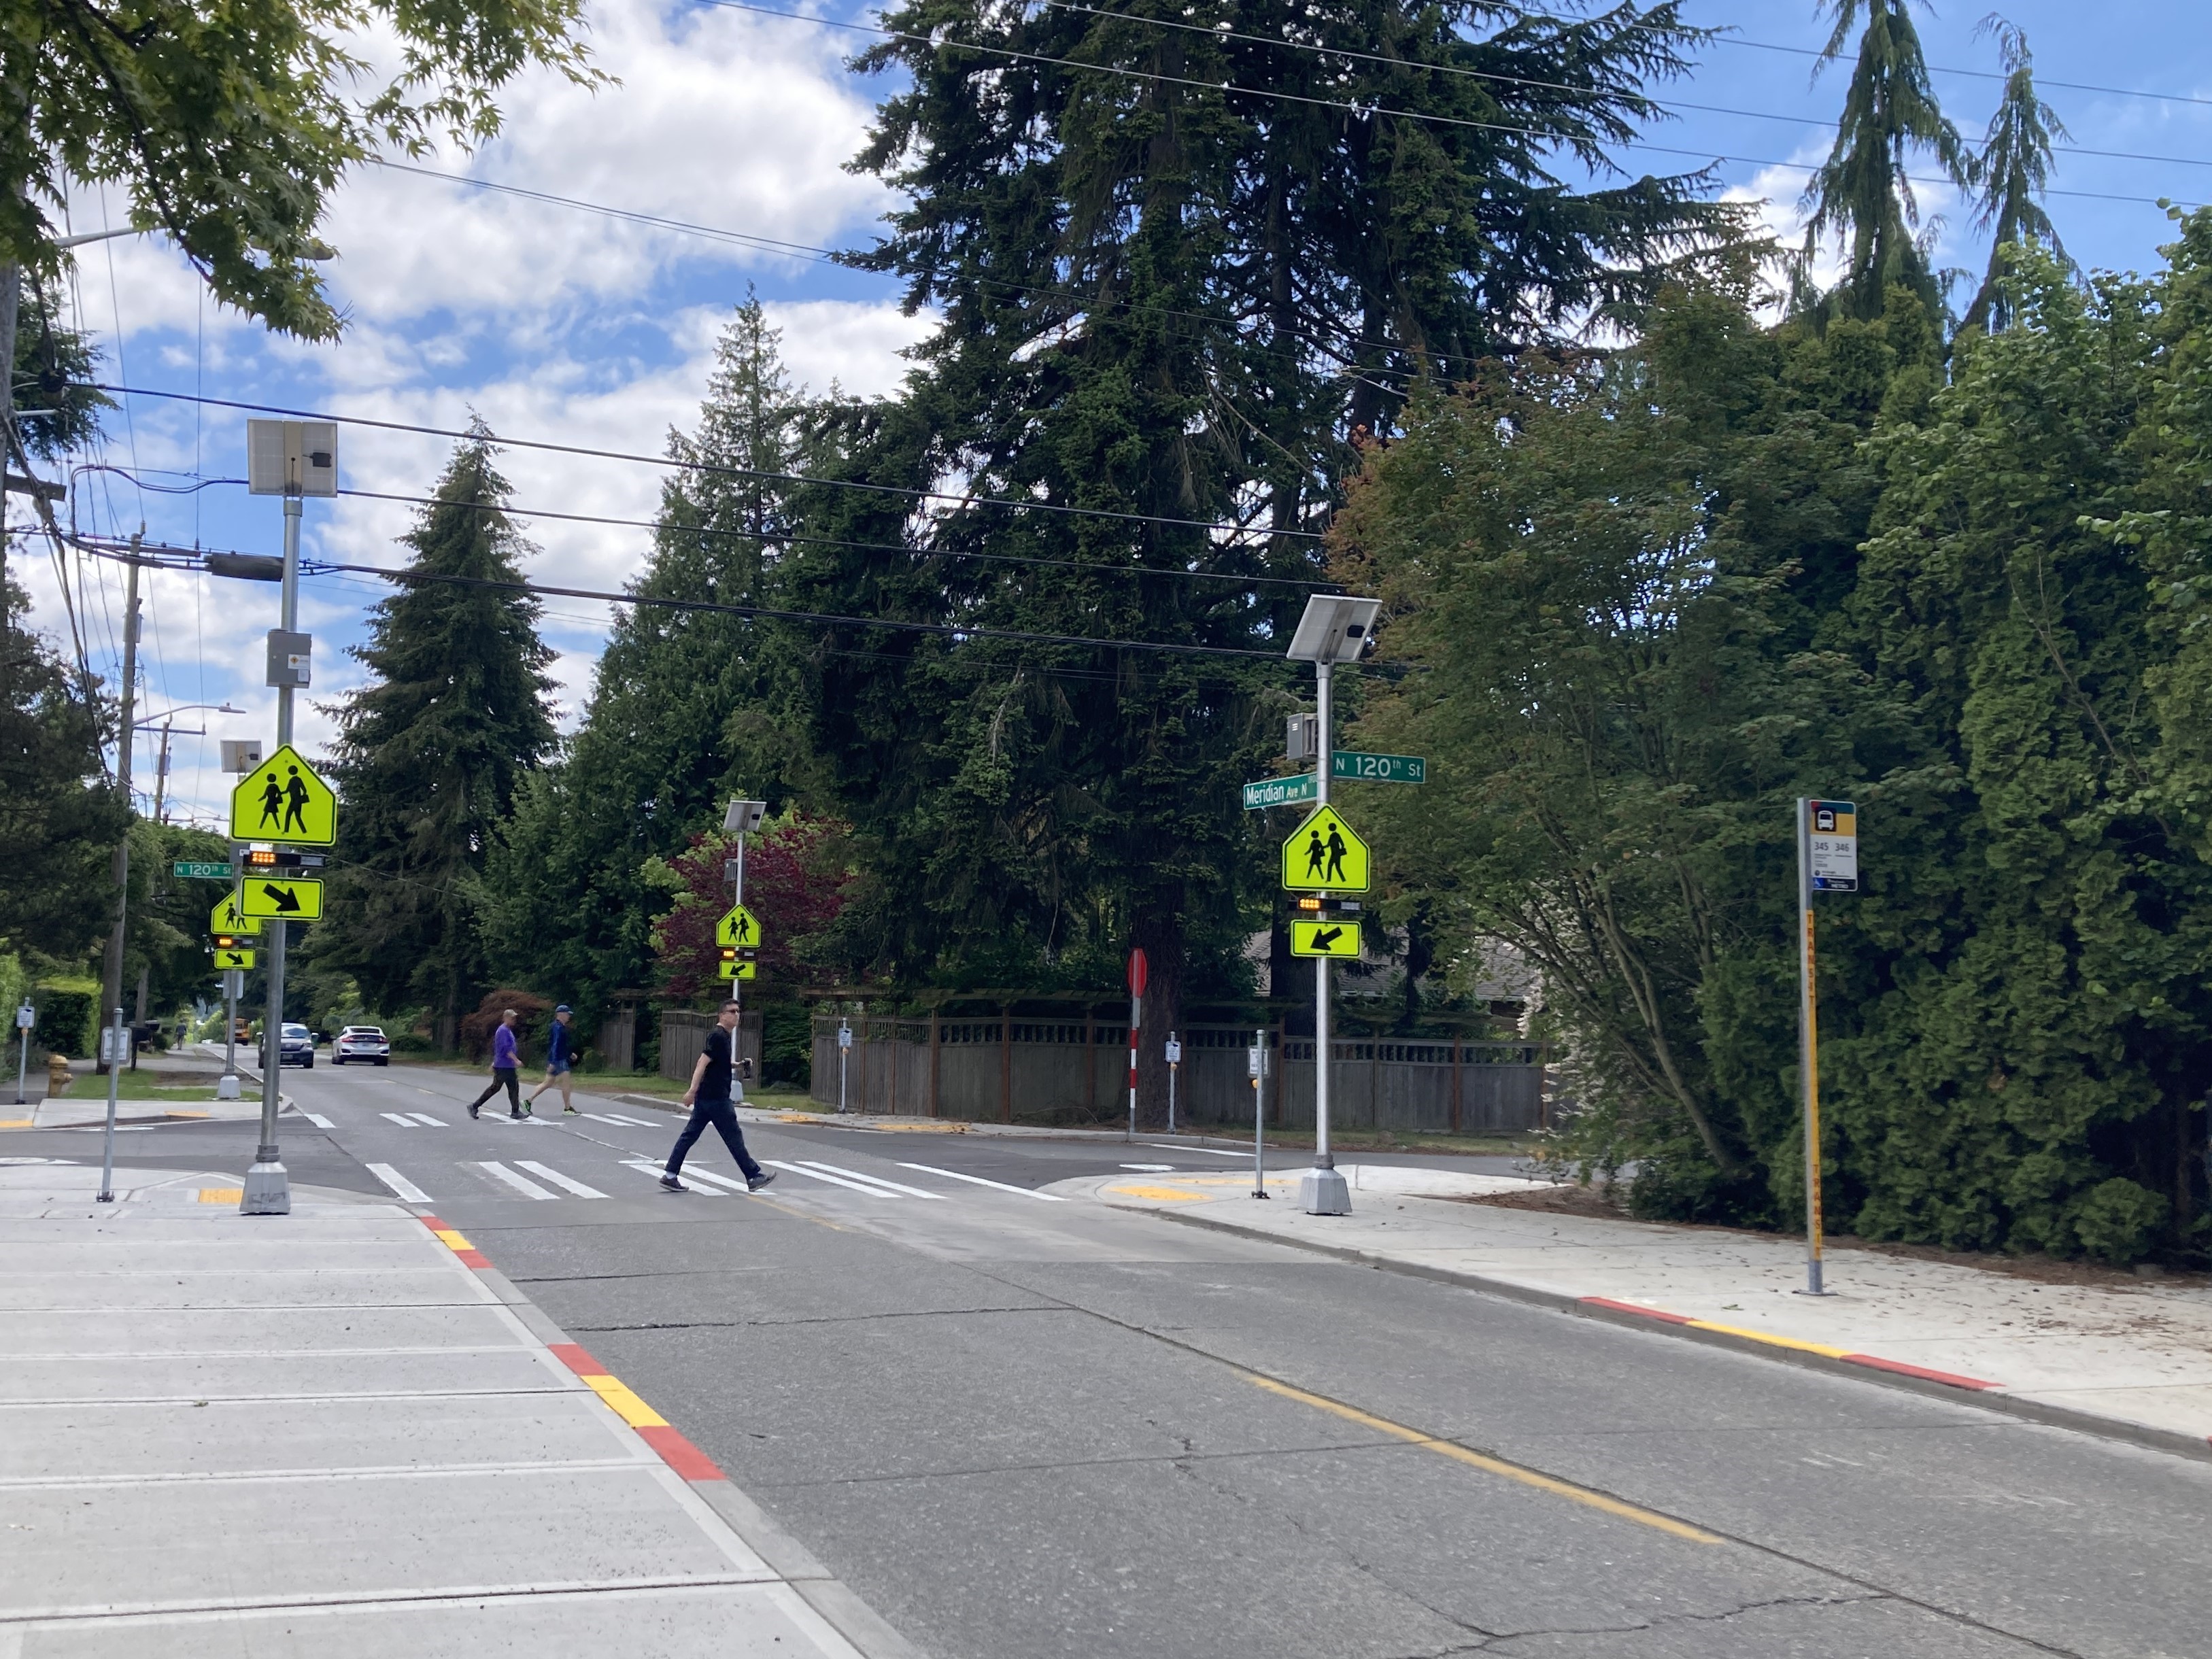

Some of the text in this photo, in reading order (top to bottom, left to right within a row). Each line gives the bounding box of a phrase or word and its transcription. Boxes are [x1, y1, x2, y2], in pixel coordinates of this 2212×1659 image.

[1335, 756, 1421, 777] N 120th St
[1246, 783, 1308, 806] Meridian Ave N
[1814, 842, 1850, 852] 345 346
[177, 866, 183, 874] N
[222, 866, 231, 874] St
[1807, 914, 1816, 1005] TRANSIT
